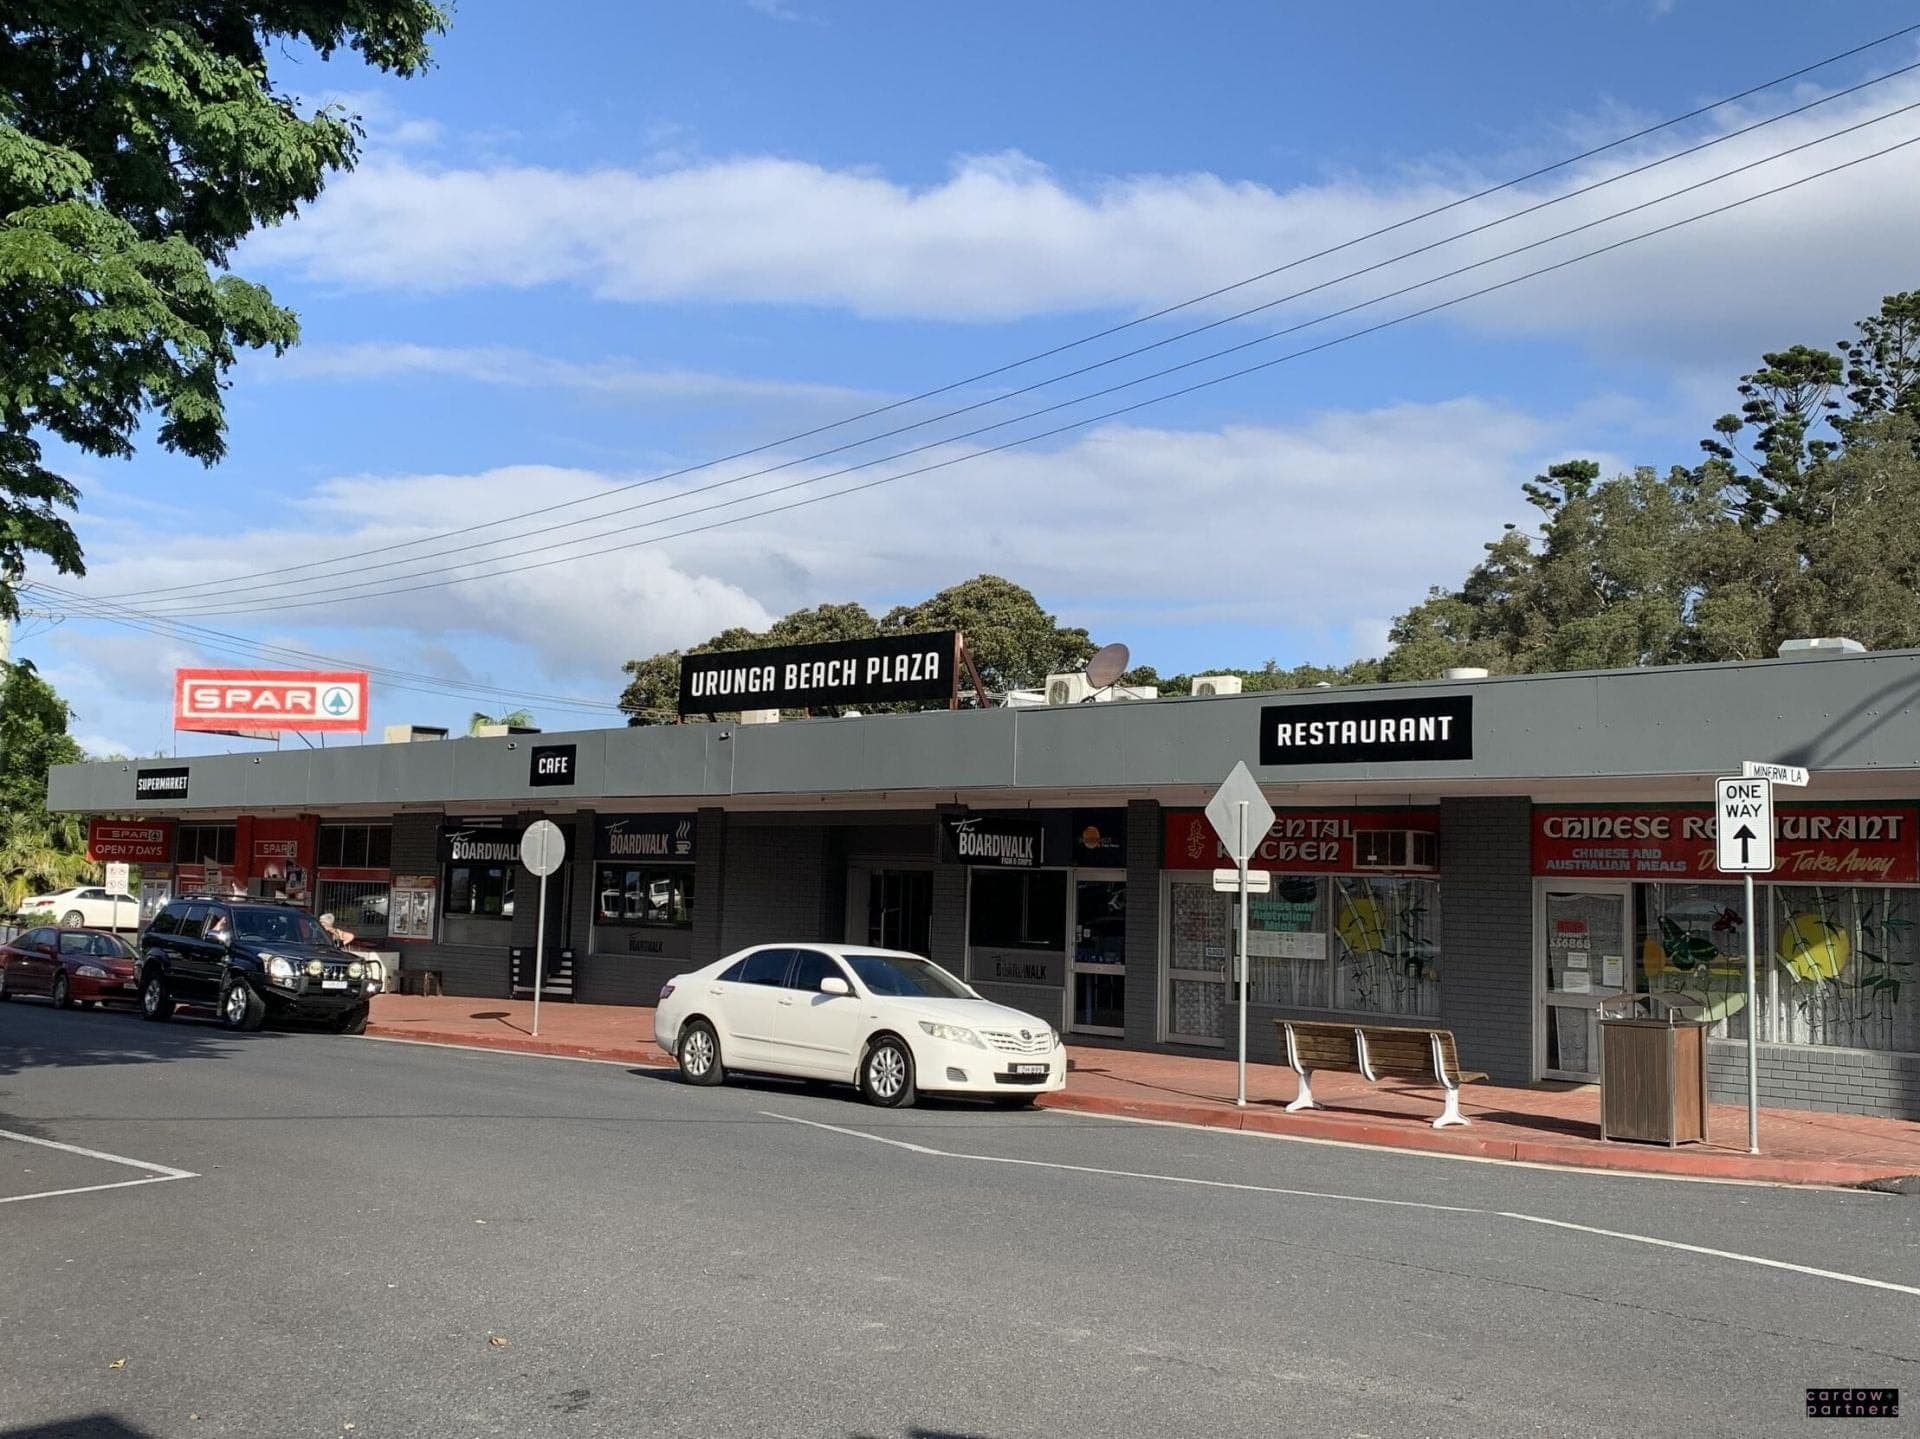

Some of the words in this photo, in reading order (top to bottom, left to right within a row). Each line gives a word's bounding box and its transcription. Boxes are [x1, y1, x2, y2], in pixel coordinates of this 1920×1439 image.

[691, 665, 775, 697] URUNGA
[784, 658, 856, 690] BEACH
[866, 651, 939, 684] PLAZA
[193, 688, 312, 711] SPAR
[1276, 715, 1453, 746] RESTAURANT
[538, 756, 568, 774] CAFE
[1753, 764, 1788, 781] MINERVA
[1791, 769, 1802, 783] LA
[137, 776, 188, 791] SUPERMARKET
[1726, 784, 1761, 799] ONE
[1726, 804, 1762, 818] WAY
[111, 829, 149, 839] SPAR
[951, 818, 983, 833] The
[1268, 818, 1355, 839] ENTAL
[1543, 816, 1671, 839] CHINESE
[1682, 815, 1904, 840] REURANT
[95, 844, 126, 855] OPEN
[128, 846, 134, 855] 7
[136, 846, 163, 856] DAYS
[610, 833, 669, 855] BOARDWALK
[959, 833, 1033, 859] BOARDWALK
[1217, 841, 1340, 862] KCHEN
[1572, 848, 1630, 859] CHINESE
[1633, 849, 1662, 859] AND
[1546, 860, 1631, 871] AUSTRALIAN
[1637, 860, 1687, 872] MEALS
[1791, 850, 1844, 875] Take
[1838, 848, 1895, 877] Away
